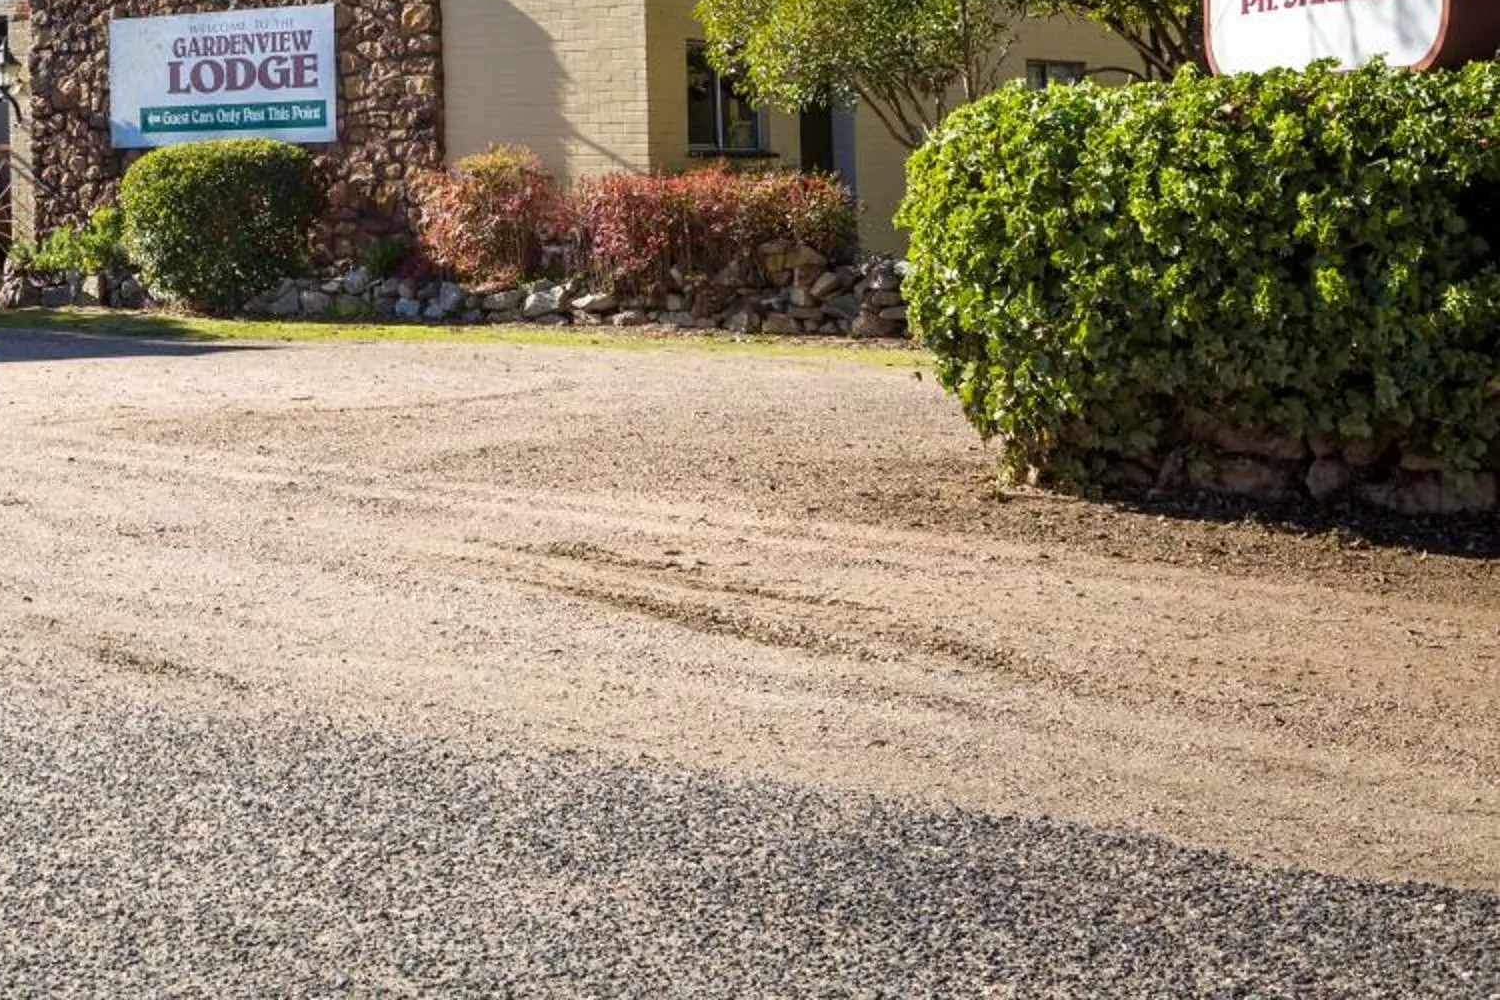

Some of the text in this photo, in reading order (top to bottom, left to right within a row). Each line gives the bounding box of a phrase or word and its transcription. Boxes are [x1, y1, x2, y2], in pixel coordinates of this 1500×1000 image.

[173, 29, 312, 59] GARDENVIEW
[167, 53, 319, 95] LODGE
[163, 105, 321, 126] Guest Cars Only Past This Point
